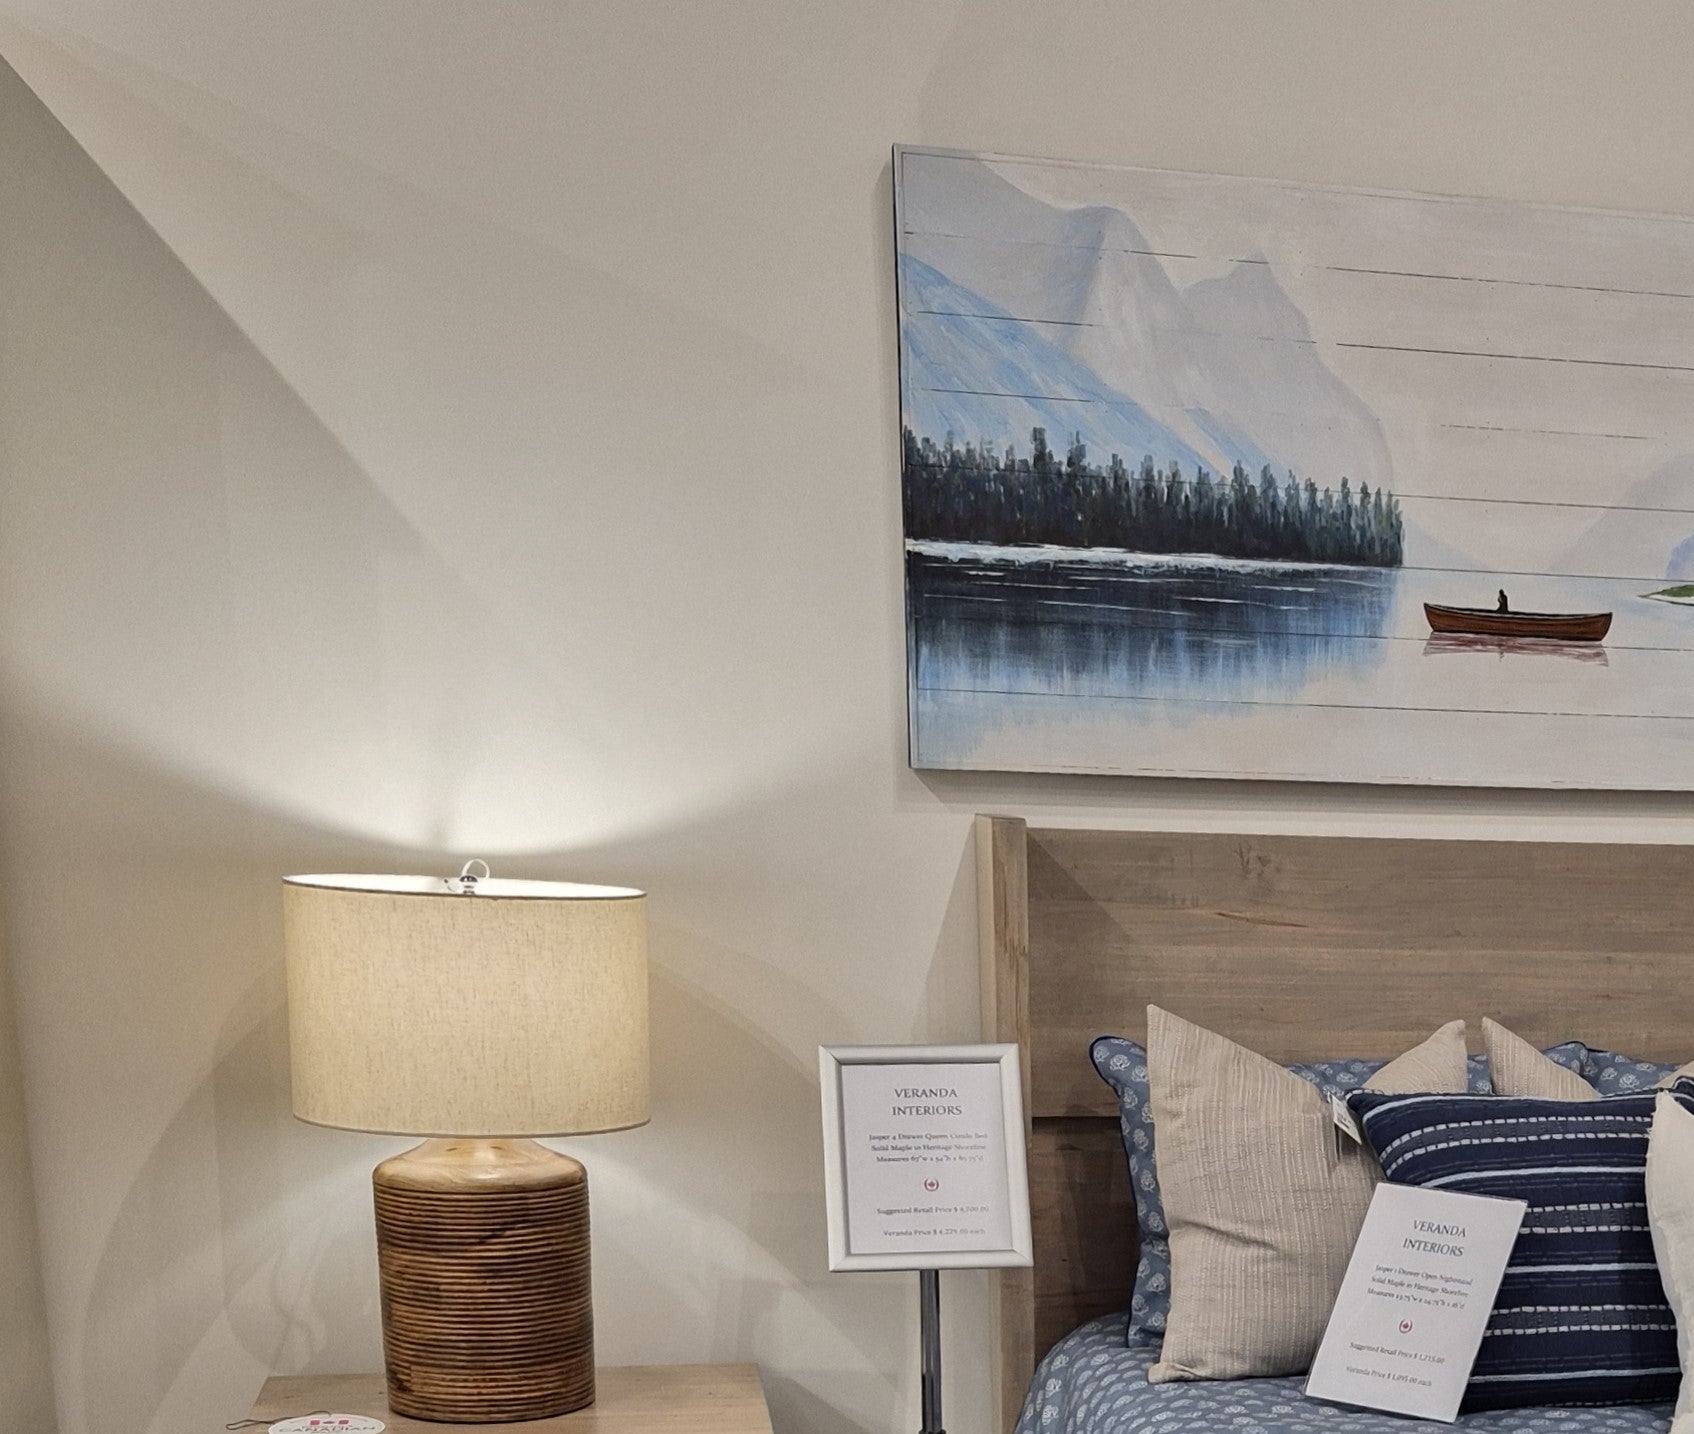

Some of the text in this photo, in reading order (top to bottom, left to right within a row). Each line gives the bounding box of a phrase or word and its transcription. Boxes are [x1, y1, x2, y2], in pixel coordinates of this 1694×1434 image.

[894, 1088, 958, 1098] VERANDA
[892, 1105, 963, 1116] INTERIORS
[1413, 1219, 1466, 1238] VERANDA
[1402, 1237, 1465, 1257] INTERIORS
